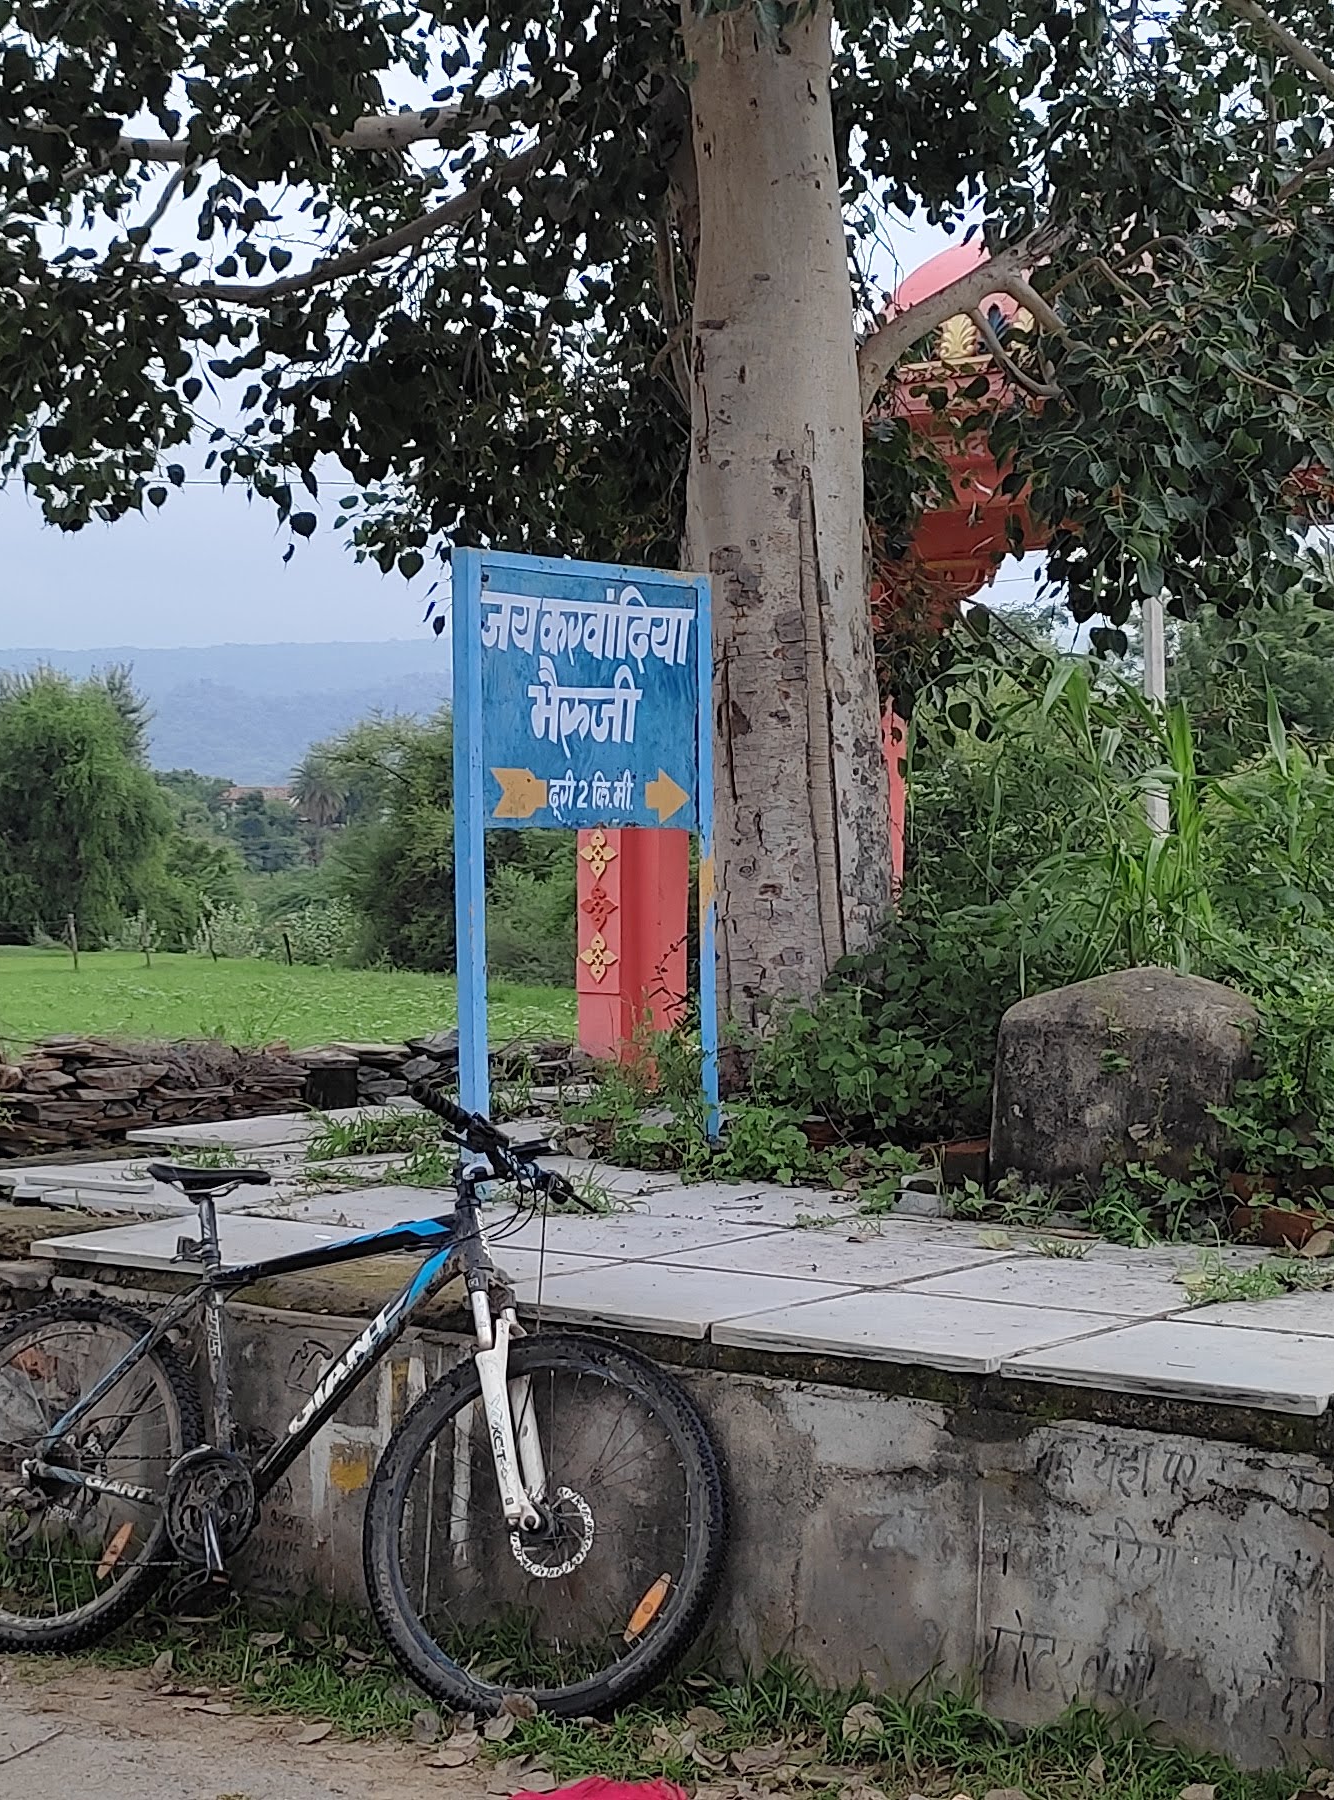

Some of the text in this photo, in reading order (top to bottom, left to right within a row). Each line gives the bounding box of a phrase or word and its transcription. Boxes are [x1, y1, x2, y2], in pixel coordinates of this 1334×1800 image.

[480, 590, 542, 656] जय
[548, 768, 577, 822] दूरी
[577, 781, 589, 809] 2
[288, 1301, 392, 1435] GIANT
[84, 1476, 154, 1500] GIANT
